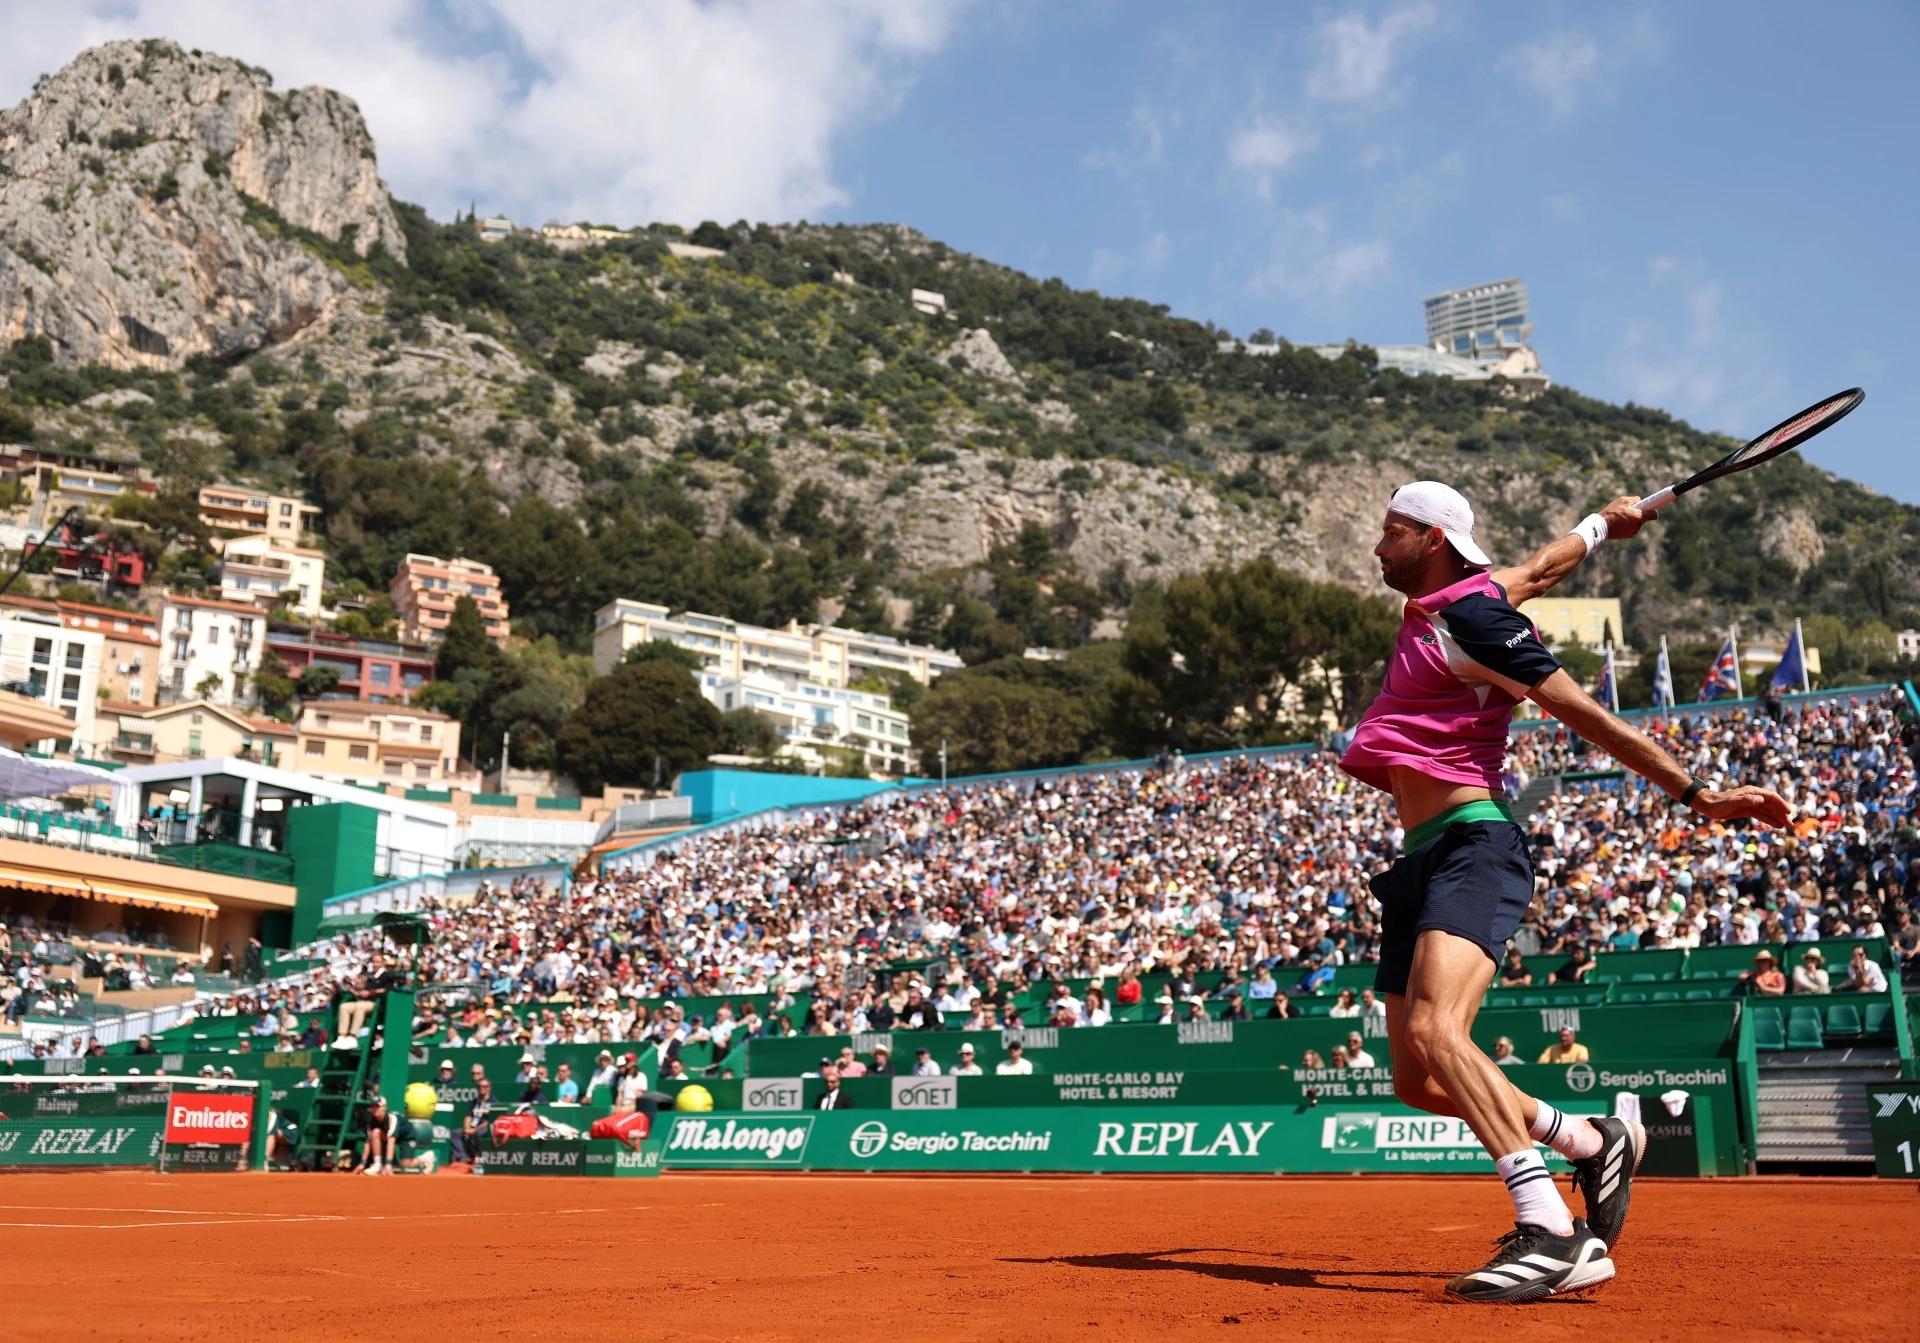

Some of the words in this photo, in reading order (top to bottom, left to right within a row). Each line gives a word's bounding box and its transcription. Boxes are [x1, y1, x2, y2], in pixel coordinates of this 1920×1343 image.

[1363, 1016, 1388, 1038] PAR
[1540, 1008, 1581, 1033] TURIN
[1001, 1028, 1059, 1050] CINCINNATI
[1178, 1021, 1233, 1044] SHANGHAI
[1053, 1072, 1151, 1086] MONTE-CARLO
[1156, 1071, 1185, 1084] BAY
[1293, 1068, 1393, 1082] MONTE-CARL
[1599, 1070, 1654, 1089] Sergio
[1654, 1068, 1727, 1086] Tacchini
[435, 1084, 479, 1102] decco
[1060, 1087, 1105, 1100] HOTEL
[1108, 1086, 1119, 1099] &
[1122, 1085, 1179, 1099] RESORT
[1302, 1083, 1353, 1097] HOTEL
[1356, 1083, 1368, 1096] &
[172, 1106, 249, 1129] Emirates
[27, 1127, 137, 1155] REPLAY
[669, 1119, 806, 1160] Malongo
[889, 1131, 959, 1155] Sergio
[961, 1131, 1052, 1151] Tacchini
[1092, 1121, 1275, 1157] REPLAY
[1387, 1121, 1448, 1143] BNP
[482, 1151, 527, 1166] REPLAY
[531, 1151, 580, 1166] REPLAY
[616, 1151, 660, 1168] REPLAY
[1385, 1151, 1399, 1161] La
[1401, 1150, 1445, 1163] banque
[1447, 1150, 1474, 1161] d'un
